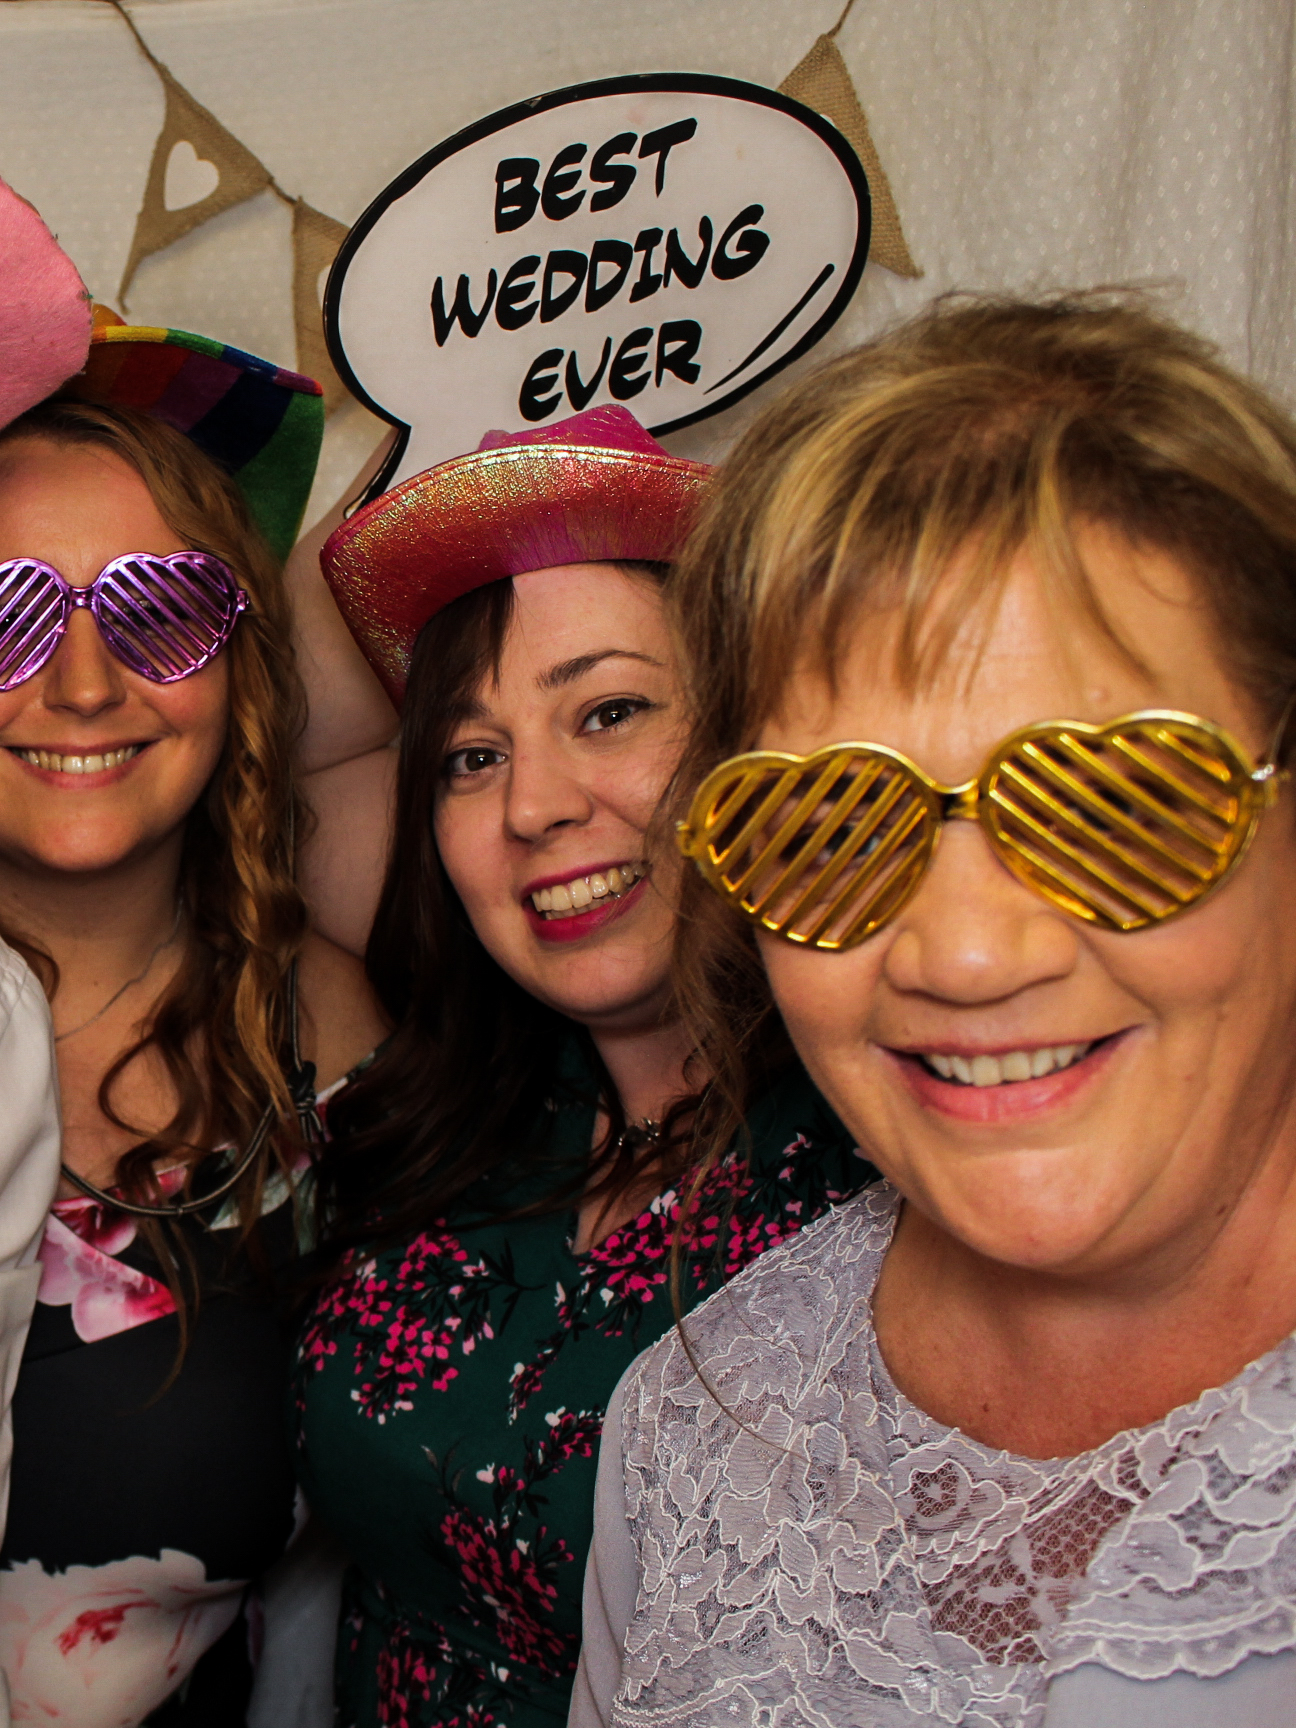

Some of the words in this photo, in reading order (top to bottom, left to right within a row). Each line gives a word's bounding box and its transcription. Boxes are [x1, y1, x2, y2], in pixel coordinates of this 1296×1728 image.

[495, 117, 698, 234] BEST
[429, 203, 771, 347] WEDDING
[518, 318, 703, 422] EVER
